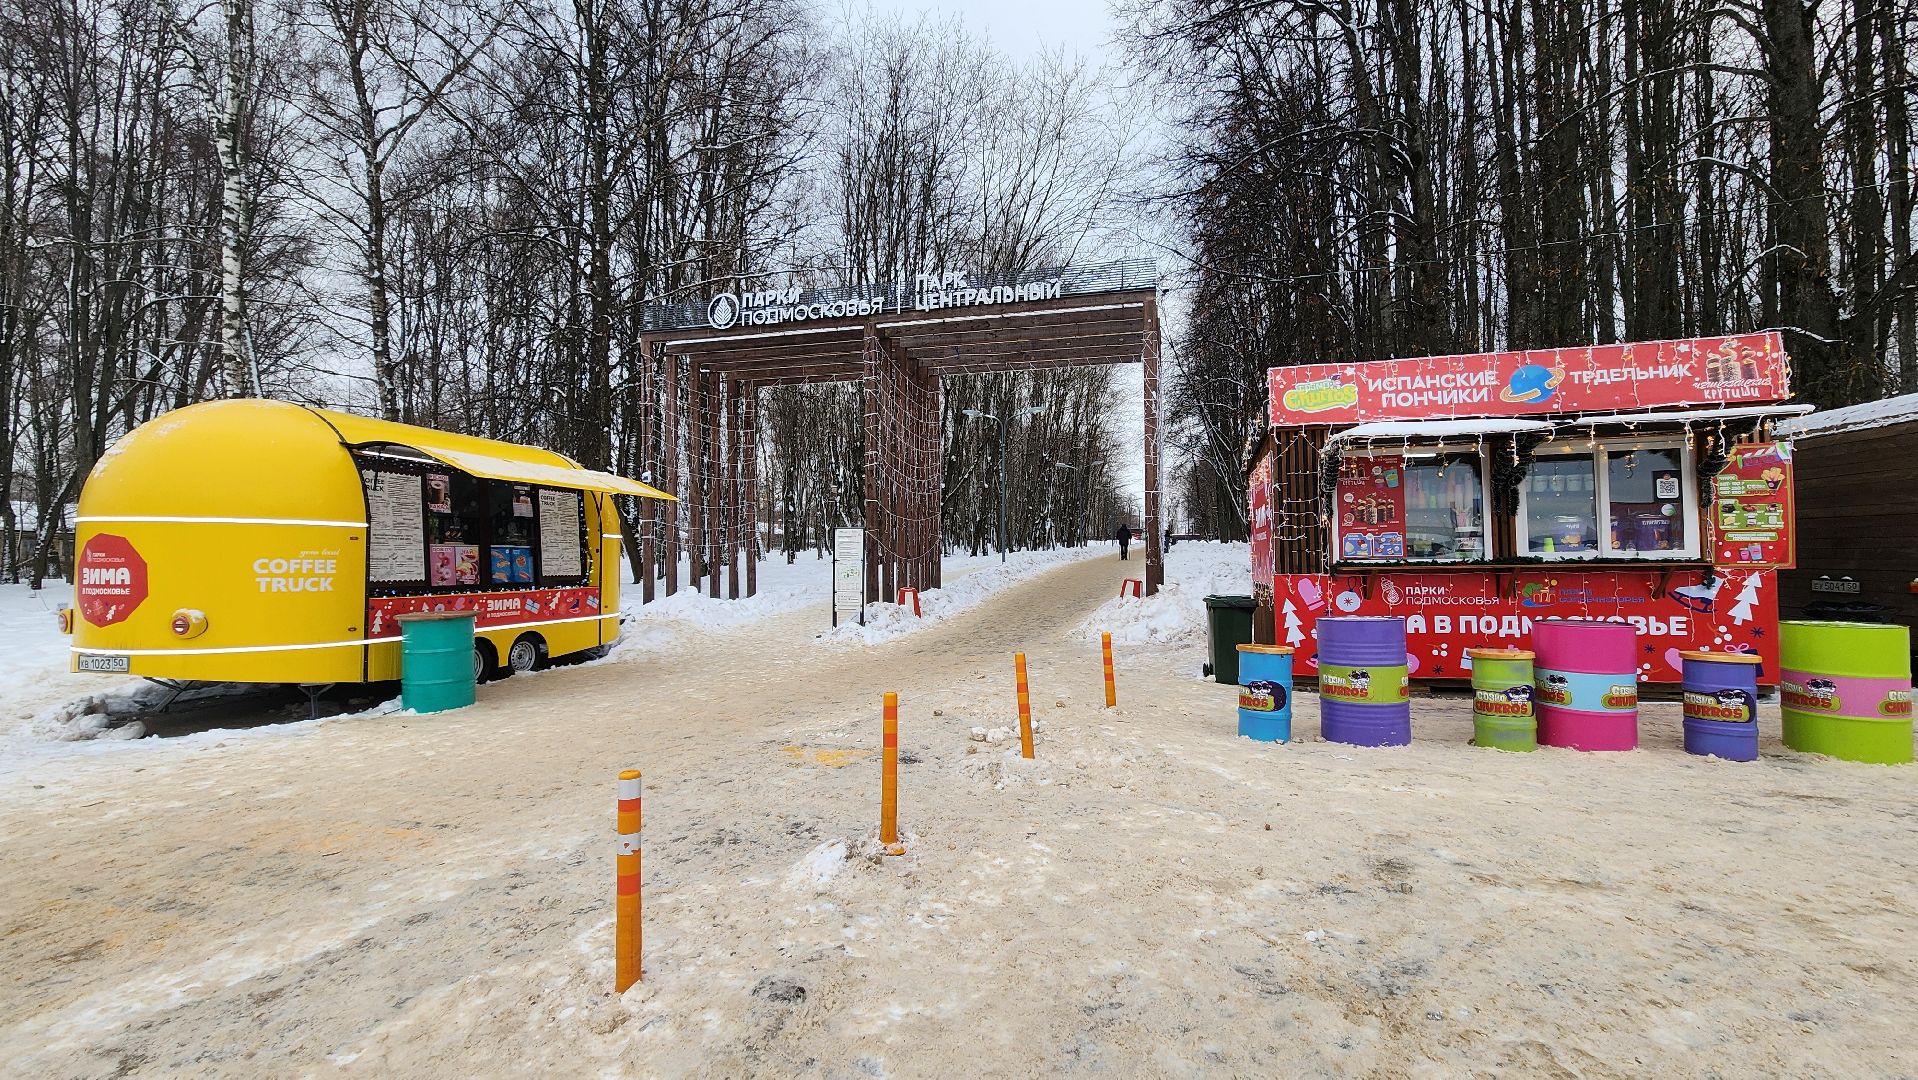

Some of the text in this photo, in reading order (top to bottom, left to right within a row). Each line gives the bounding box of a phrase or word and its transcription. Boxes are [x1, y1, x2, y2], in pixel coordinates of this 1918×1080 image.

[915, 271, 967, 291] ПАРК
[742, 287, 803, 307] ПАРКИ
[915, 279, 1062, 312] ЦЕНТРАЛЬНЫЙ
[741, 296, 884, 326] ПОДМОСКОВЬЯ
[1368, 370, 1497, 392] ИСПАНСКИЕ
[1570, 364, 1693, 386] ТРДЕЛЬНИК
[1382, 388, 1488, 408] ПОНЧИКИ
[253, 558, 337, 574] COFFEE
[82, 567, 131, 585] ЗИМА
[255, 577, 334, 592] TRUCK
[1405, 586, 1445, 595] ПАРКИ
[486, 597, 521, 611] ЗИМА
[1405, 596, 1500, 606] ПОДМОСКОВЬЯ
[1434, 615, 1452, 634] В
[90, 658, 111, 670] 1023
[113, 658, 124, 667] 50
[1475, 700, 1528, 714] CHURROS
